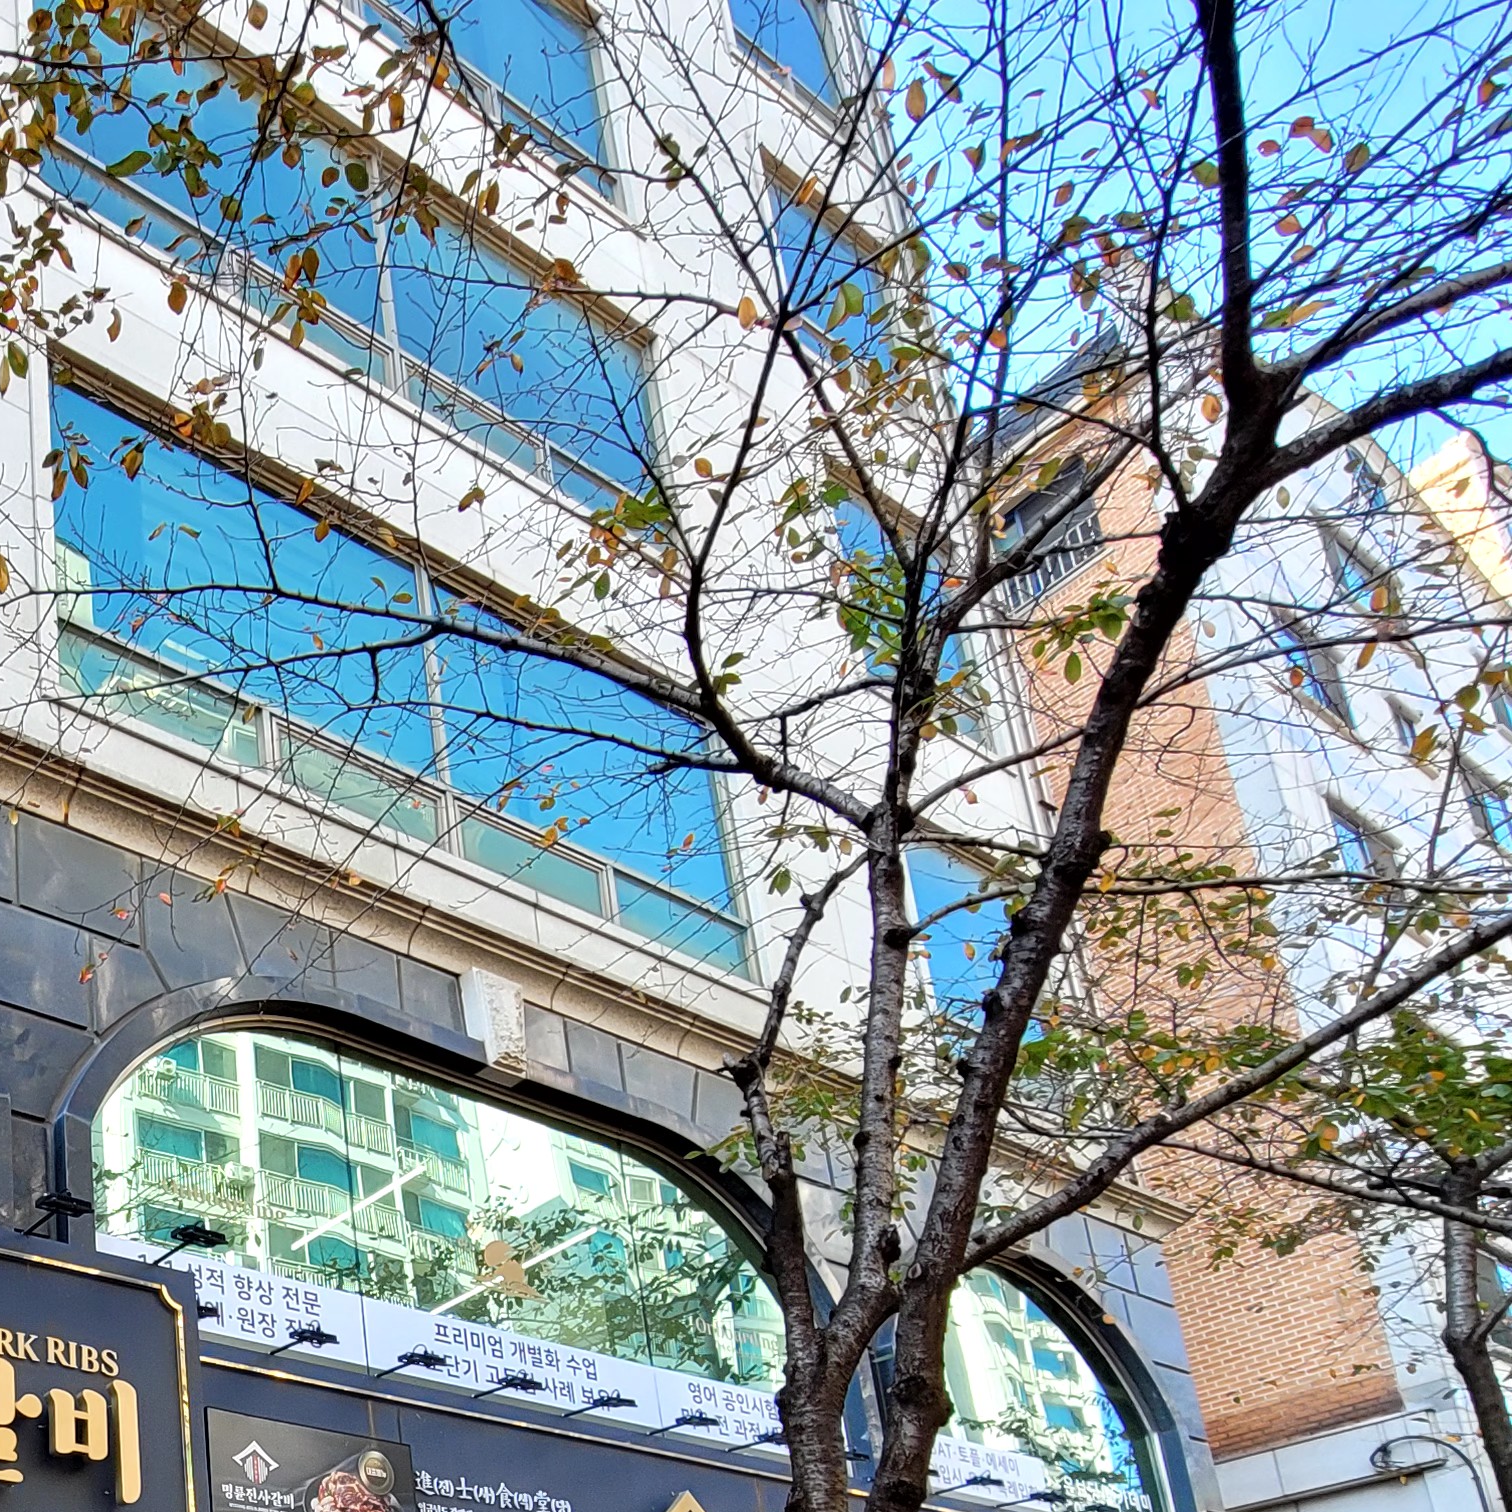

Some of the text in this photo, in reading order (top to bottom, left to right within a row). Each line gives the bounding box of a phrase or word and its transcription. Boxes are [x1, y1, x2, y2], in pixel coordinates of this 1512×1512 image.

[233, 1273, 275, 1305] 향상
[282, 1286, 322, 1317] 전문
[45, 1336, 121, 1378] RIBS
[433, 1323, 598, 1381] 프리미엄 개별화 수업
[543, 1380, 576, 1404] 사례
[688, 1381, 717, 1408] 영어
[931, 1442, 1020, 1476] AT·토플·에세이
[221, 1483, 295, 1510] 명륜진사갈비
